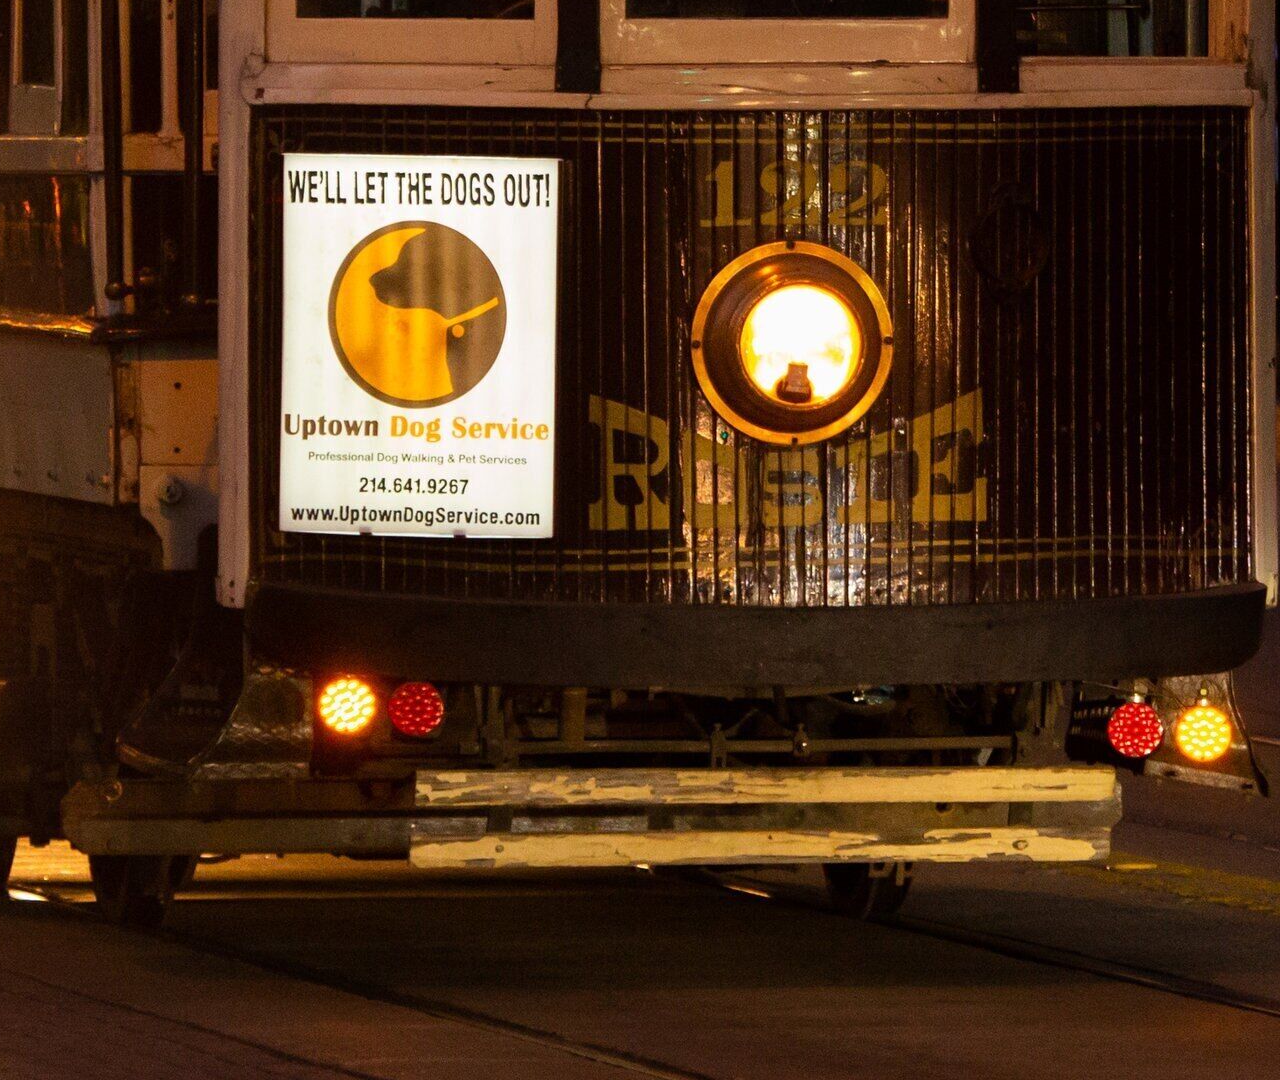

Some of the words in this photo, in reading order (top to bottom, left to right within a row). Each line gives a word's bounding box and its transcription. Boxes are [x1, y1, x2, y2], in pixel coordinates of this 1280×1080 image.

[288, 170, 347, 204] WE'LL
[354, 171, 388, 205] LET
[395, 172, 433, 205] THE
[441, 172, 495, 206] DOGS
[504, 173, 550, 208] OUT!
[700, 159, 889, 227] 122
[284, 414, 379, 440] Uptown
[390, 415, 441, 442] Dog
[451, 416, 549, 440] Service
[308, 451, 374, 462] Professional
[377, 452, 398, 464] Dog
[401, 453, 444, 465] Walking
[447, 454, 455, 463] &
[458, 454, 476, 464] Pet
[479, 455, 528, 465] Services
[359, 477, 469, 495] 214.641.9267
[291, 505, 540, 526] www.UptownDogService.com
